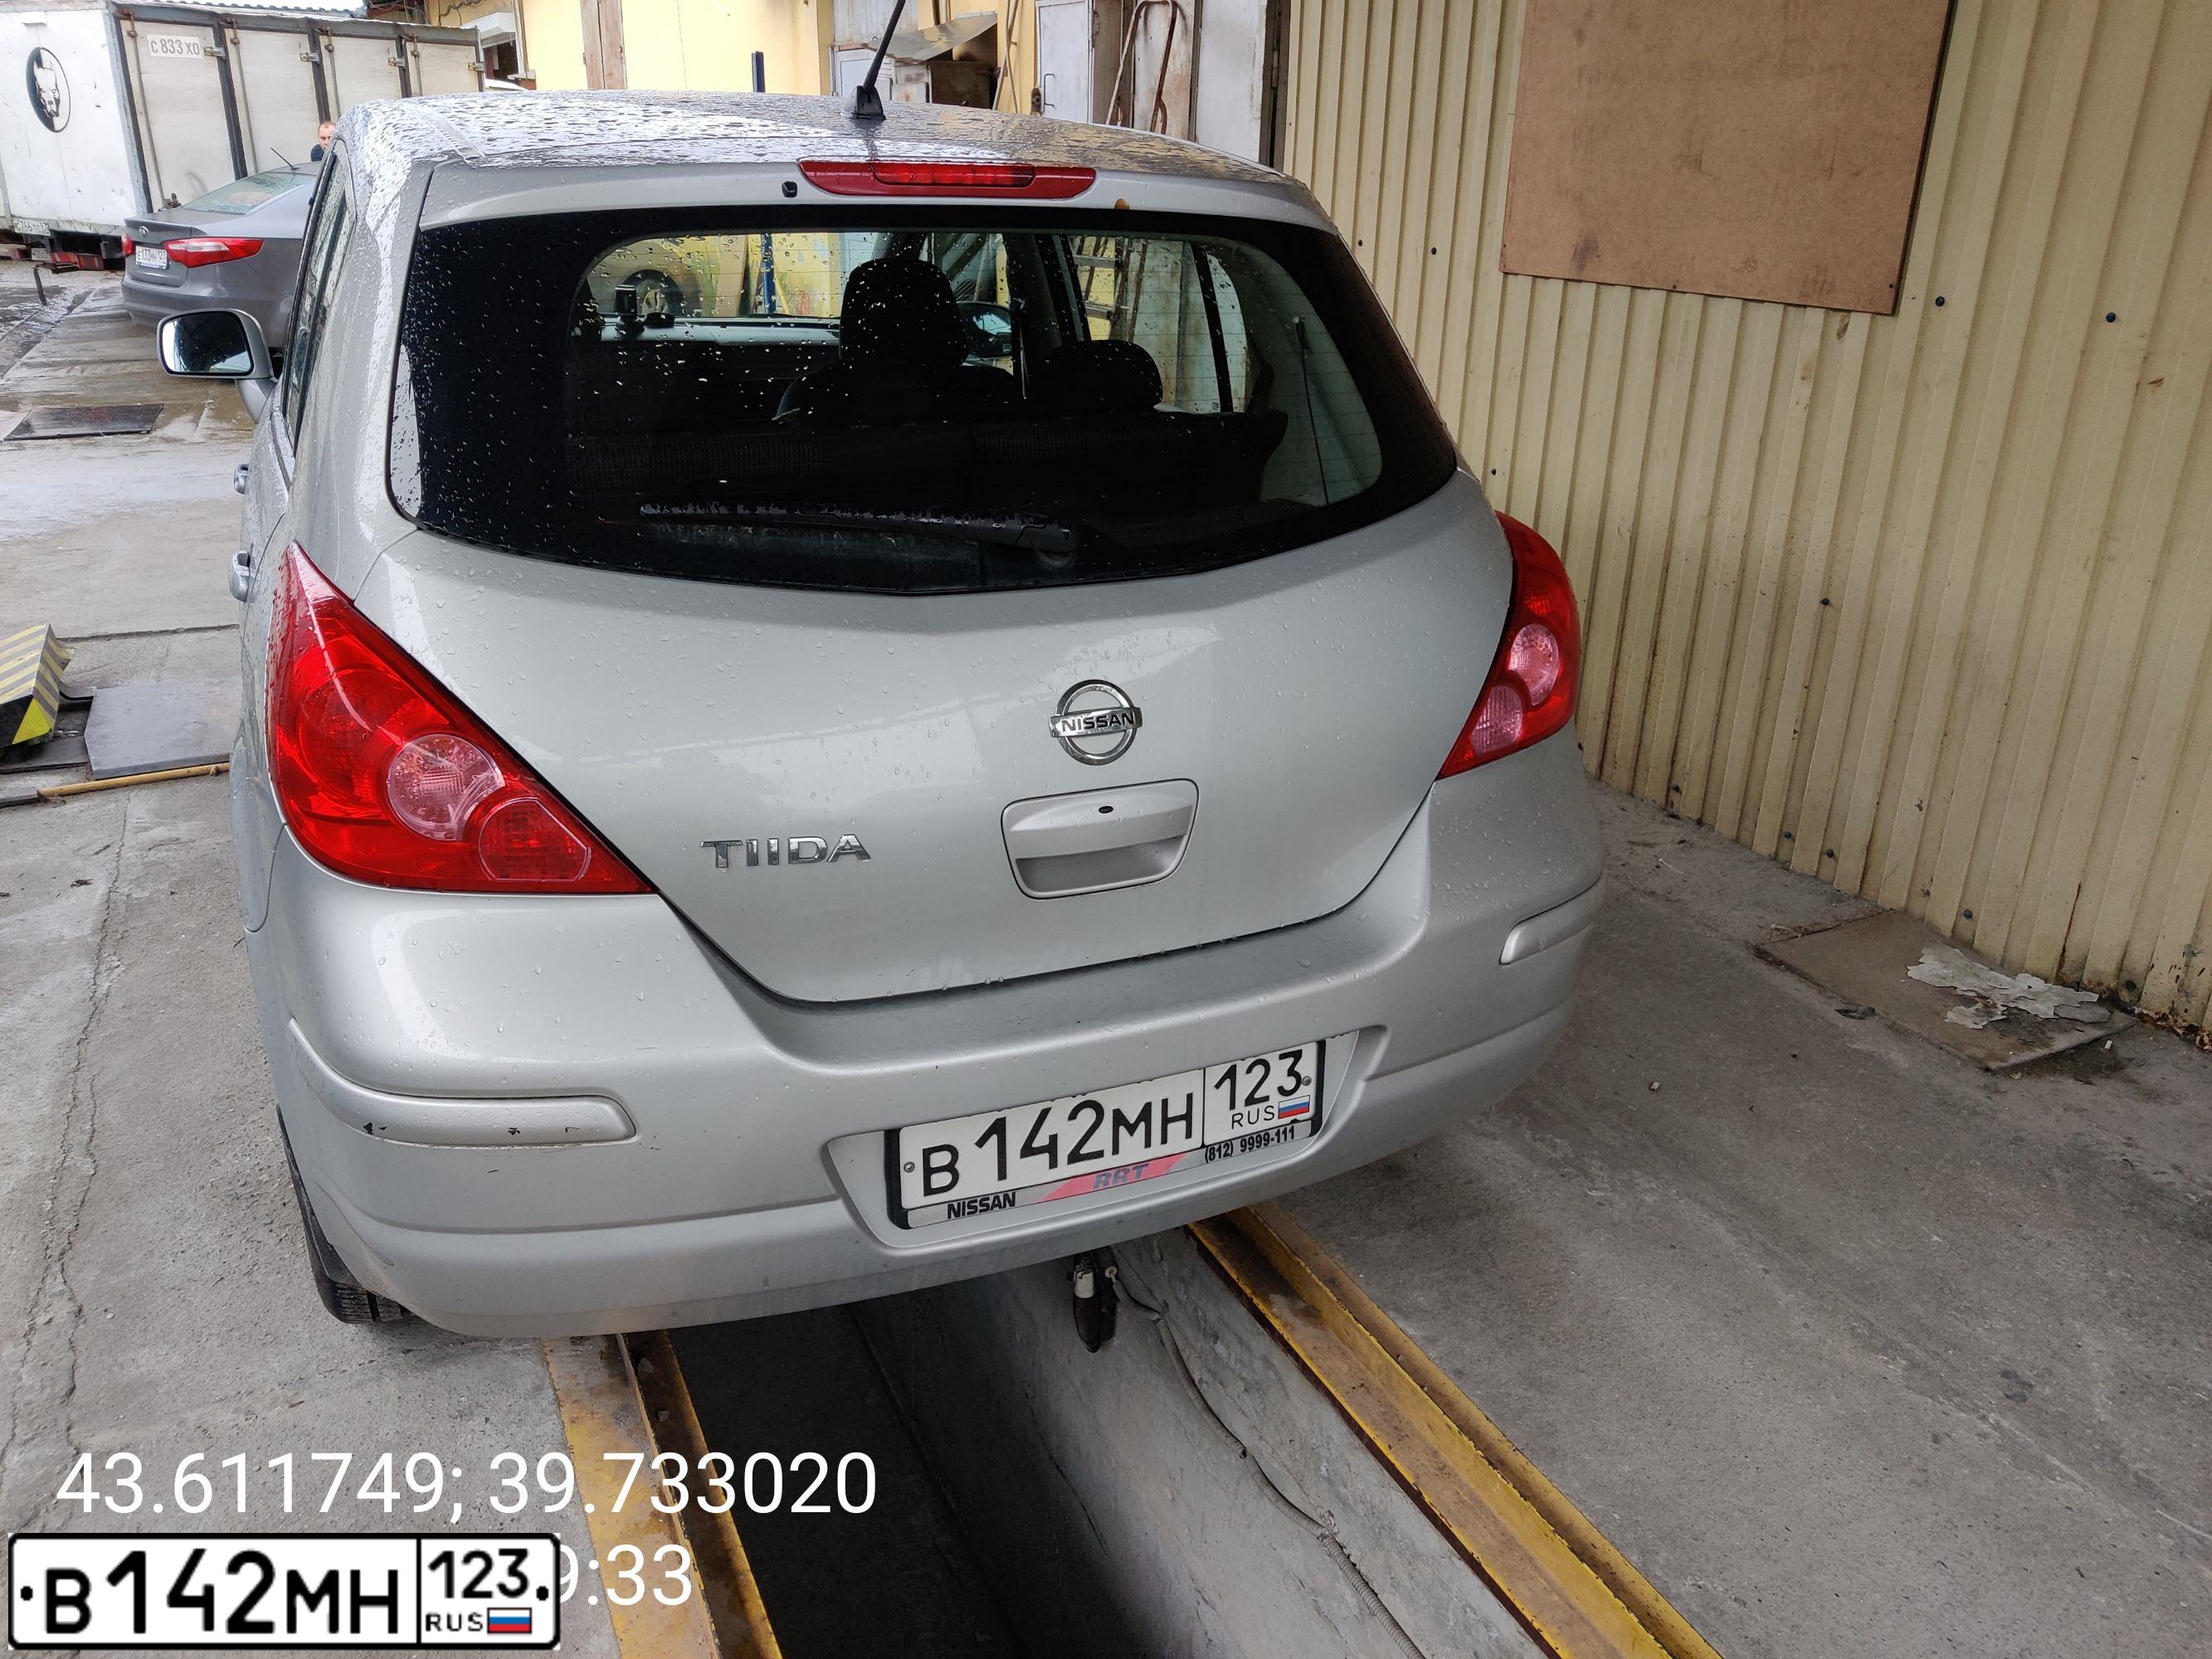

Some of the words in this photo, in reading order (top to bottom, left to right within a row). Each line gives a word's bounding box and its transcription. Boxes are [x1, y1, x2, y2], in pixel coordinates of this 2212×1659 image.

[160, 38, 183, 55] 833
[1061, 711, 1135, 733] NISSAN
[699, 833, 871, 869] TIIDA
[1214, 1048, 1304, 1112] 123
[1231, 1106, 1275, 1130] RUS
[947, 1191, 1016, 1220] NISSAN
[1092, 1163, 1151, 1190] RRT
[1205, 1141, 1235, 1163] (812)
[1240, 1126, 1296, 1154] 9999-111
